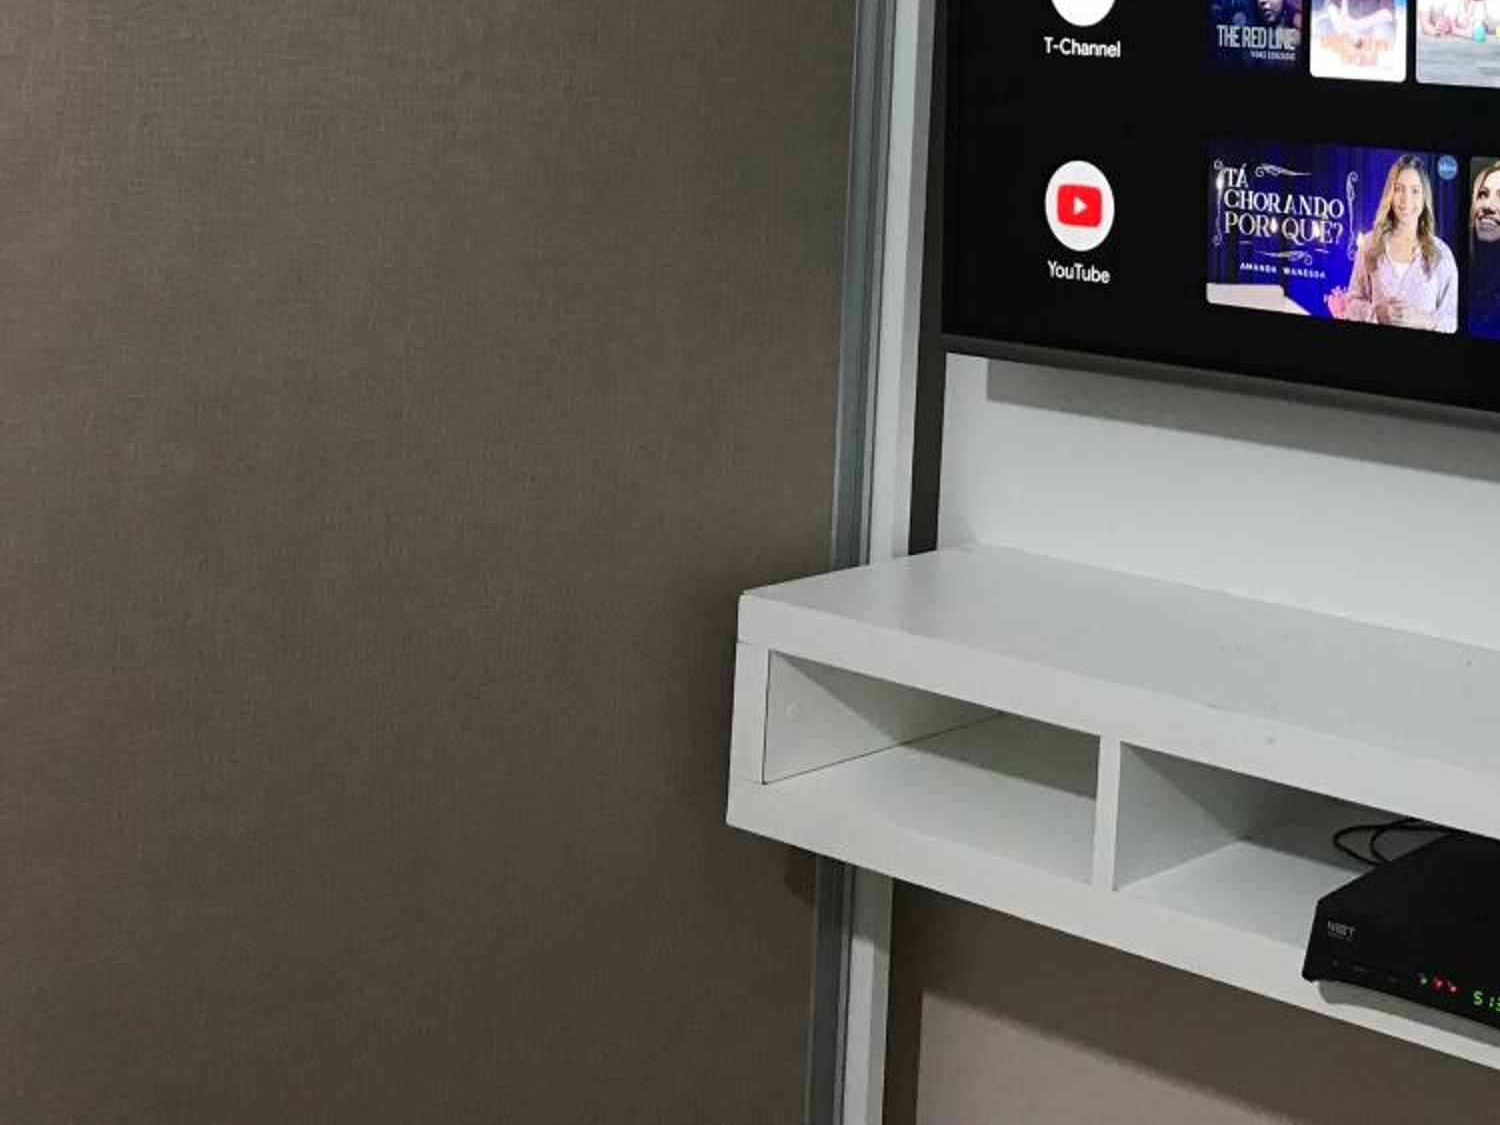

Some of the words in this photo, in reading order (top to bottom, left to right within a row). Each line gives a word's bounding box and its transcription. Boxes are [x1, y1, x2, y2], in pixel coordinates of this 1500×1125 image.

[1043, 36, 1121, 57] T-Channel
[1217, 25, 1240, 48] THE
[1242, 26, 1266, 49] RED
[1225, 163, 1249, 188] TÁ
[1223, 189, 1345, 220] CHORANDO
[1224, 211, 1271, 238] POR
[1047, 259, 1111, 284] YouTube
